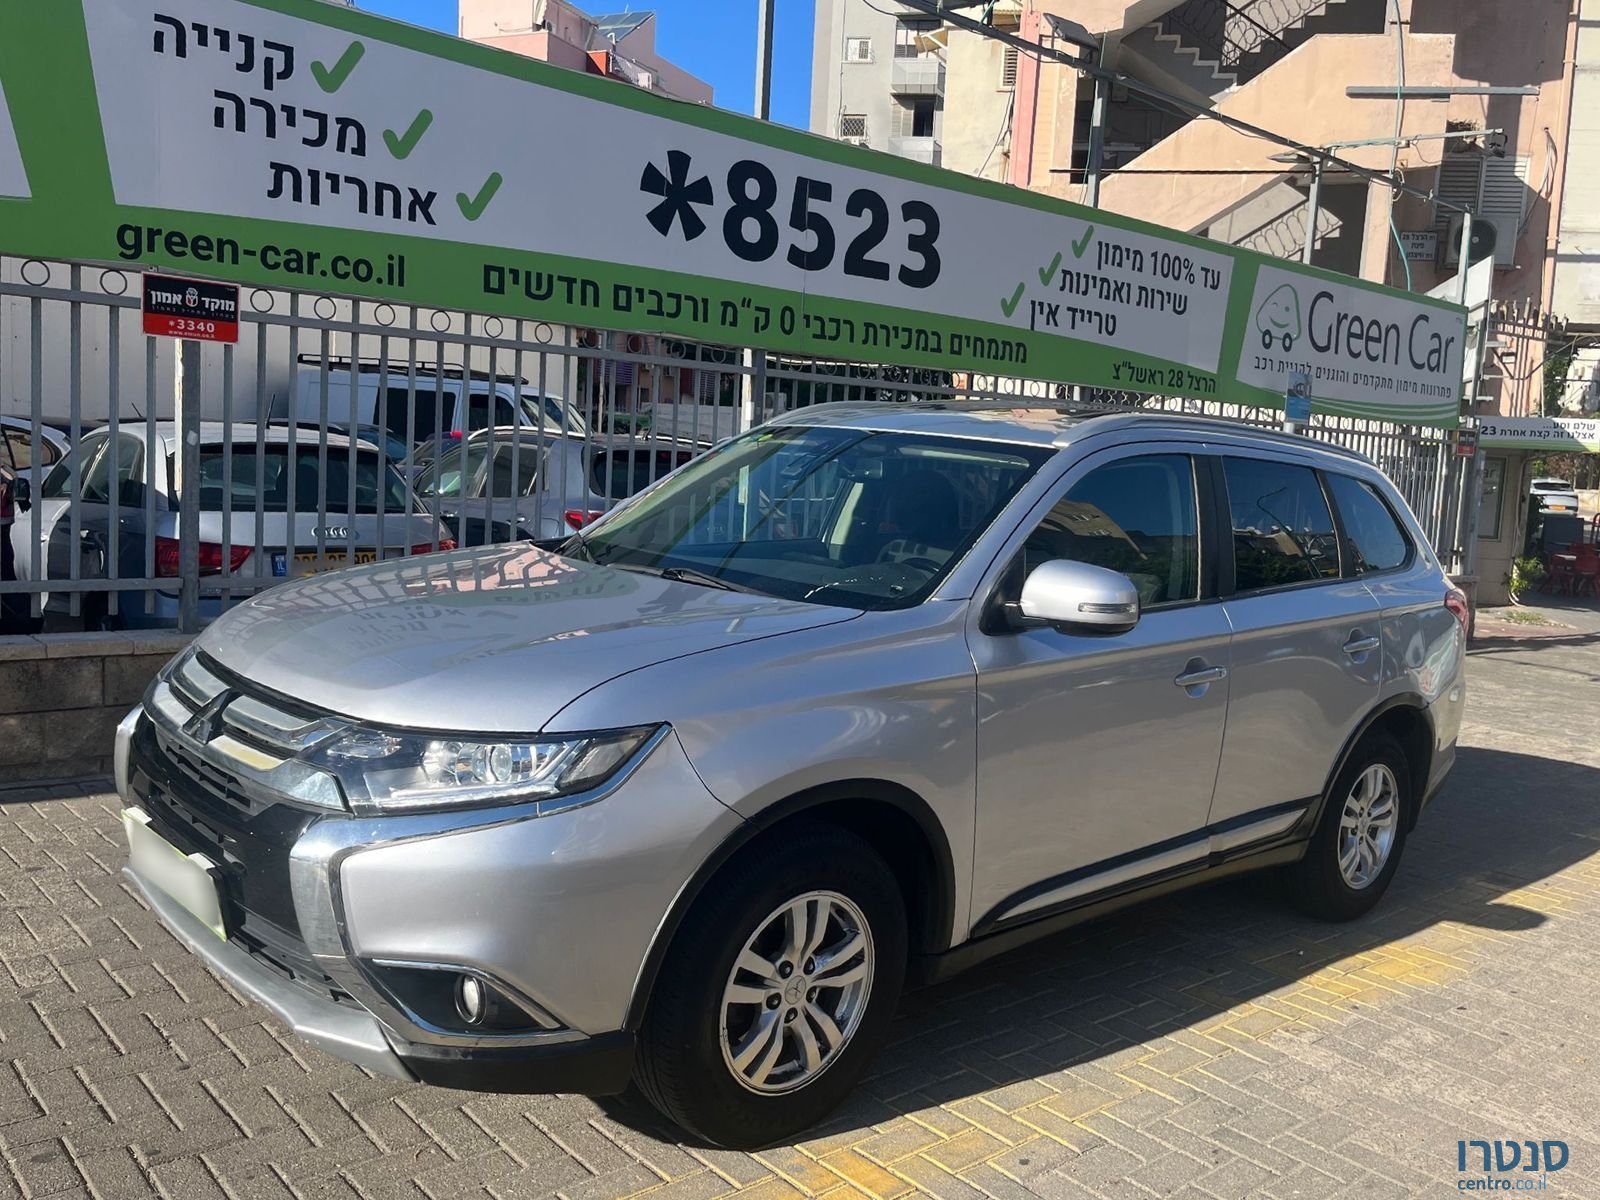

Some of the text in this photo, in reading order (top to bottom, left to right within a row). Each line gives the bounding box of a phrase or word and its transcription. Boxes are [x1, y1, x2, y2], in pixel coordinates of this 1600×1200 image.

[154, 13, 294, 90] קנייה
[214, 90, 366, 157] מכירה
[267, 161, 437, 226] אחריות
[116, 222, 405, 287] green-car.co.il
[1097, 241, 1221, 291] עד 100% מימון
[150, 290, 183, 305] אמון
[483, 264, 600, 308] חדשים
[1059, 269, 1188, 315] שירות ואמינות
[201, 297, 236, 312] מוקד
[613, 284, 710, 323] ורכבים
[803, 313, 855, 343] רכבי
[1030, 299, 1117, 336] טרייד אין
[862, 322, 943, 354] במכירת
[1308, 291, 1455, 374] Green Car
[950, 333, 1028, 363] מתמחים
[1254, 356, 1274, 371] רכב
[1315, 366, 1350, 383] והוגנים
[1167, 368, 1184, 389] 28
[1187, 370, 1216, 393] הרצל
[1352, 372, 1393, 390] מתקדמים
[1395, 380, 1418, 394] מימון
[1419, 383, 1453, 399] פתרונות
[1499, 428, 1527, 437] אחרת
[1529, 429, 1550, 440] קצת
[1553, 430, 1564, 439] זה
[1567, 432, 1595, 440] אצלנו
[1573, 421, 1596, 430] שלם
